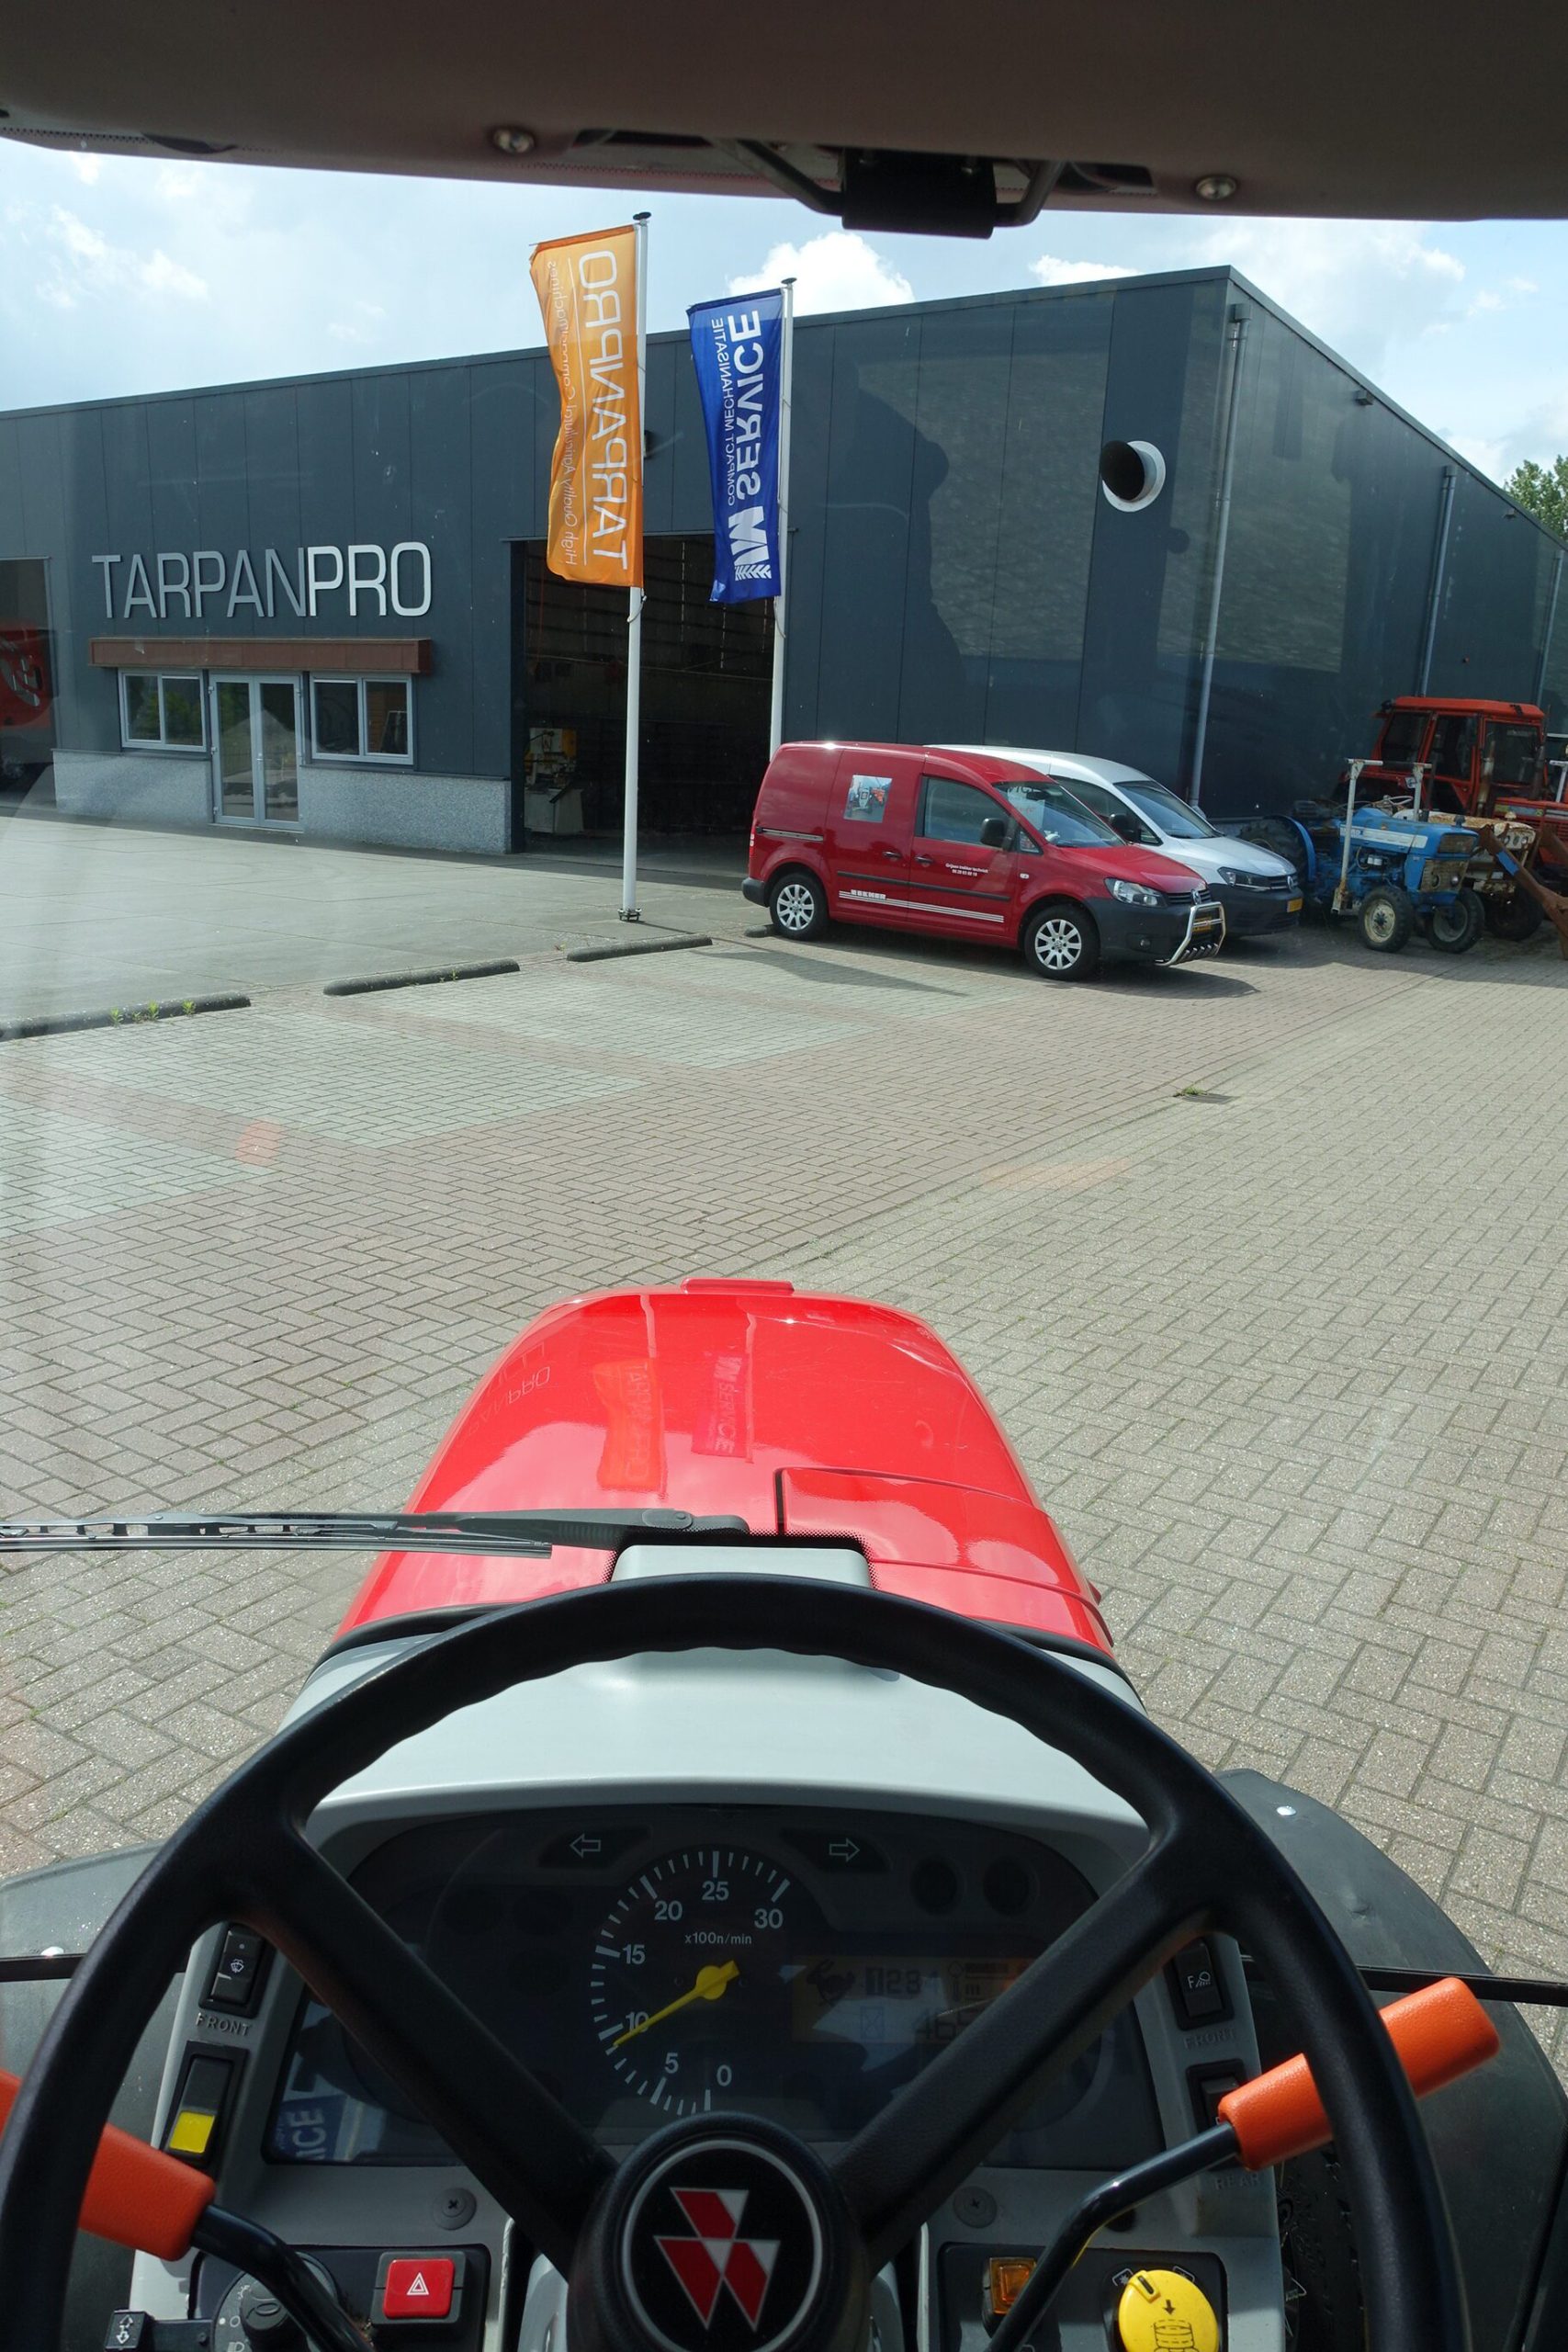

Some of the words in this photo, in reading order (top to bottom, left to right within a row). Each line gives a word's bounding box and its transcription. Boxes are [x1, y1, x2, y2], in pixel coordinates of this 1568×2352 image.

[92, 541, 432, 618] TARPANPRO
[702, 1881, 729, 1901] 25
[654, 1900, 683, 1921] 20
[754, 1908, 784, 1929] 30
[685, 1932, 752, 1945] x100n/min
[623, 1944, 646, 1965] 15
[196, 2011, 253, 2036] FRONT
[626, 2011, 649, 2032] 10
[1183, 2028, 1236, 2050] FRONT
[664, 2052, 679, 2074] 5
[716, 2064, 732, 2086] 0
[1214, 2173, 1260, 2190] REAR
